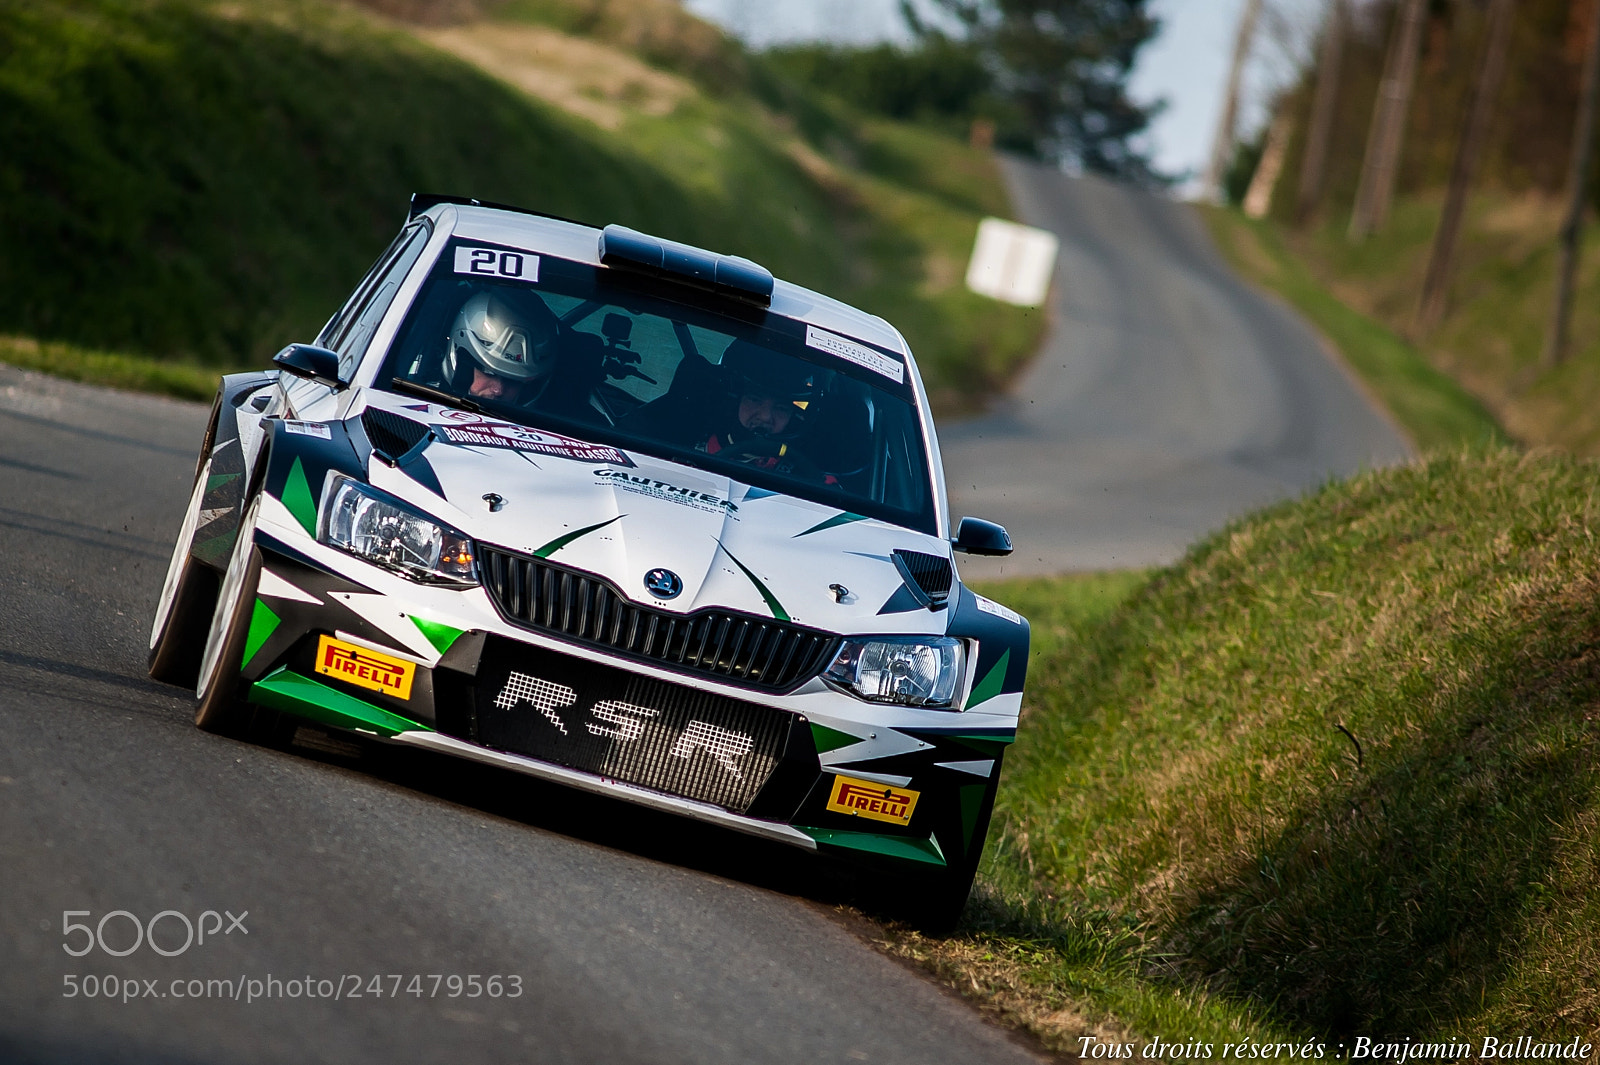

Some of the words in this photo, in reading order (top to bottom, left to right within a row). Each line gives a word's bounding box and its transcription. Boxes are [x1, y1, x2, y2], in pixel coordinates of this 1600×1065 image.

[470, 249, 524, 278] 20
[442, 426, 509, 448] BORDEAUX
[511, 439, 574, 457] AQUITAINE
[575, 447, 623, 464] CLASSIC
[513, 430, 543, 442] 20
[593, 468, 739, 513] GAUTHIER
[324, 644, 405, 689] PIRELLI
[493, 671, 753, 784] RSR
[836, 782, 911, 818] PIRELLI
